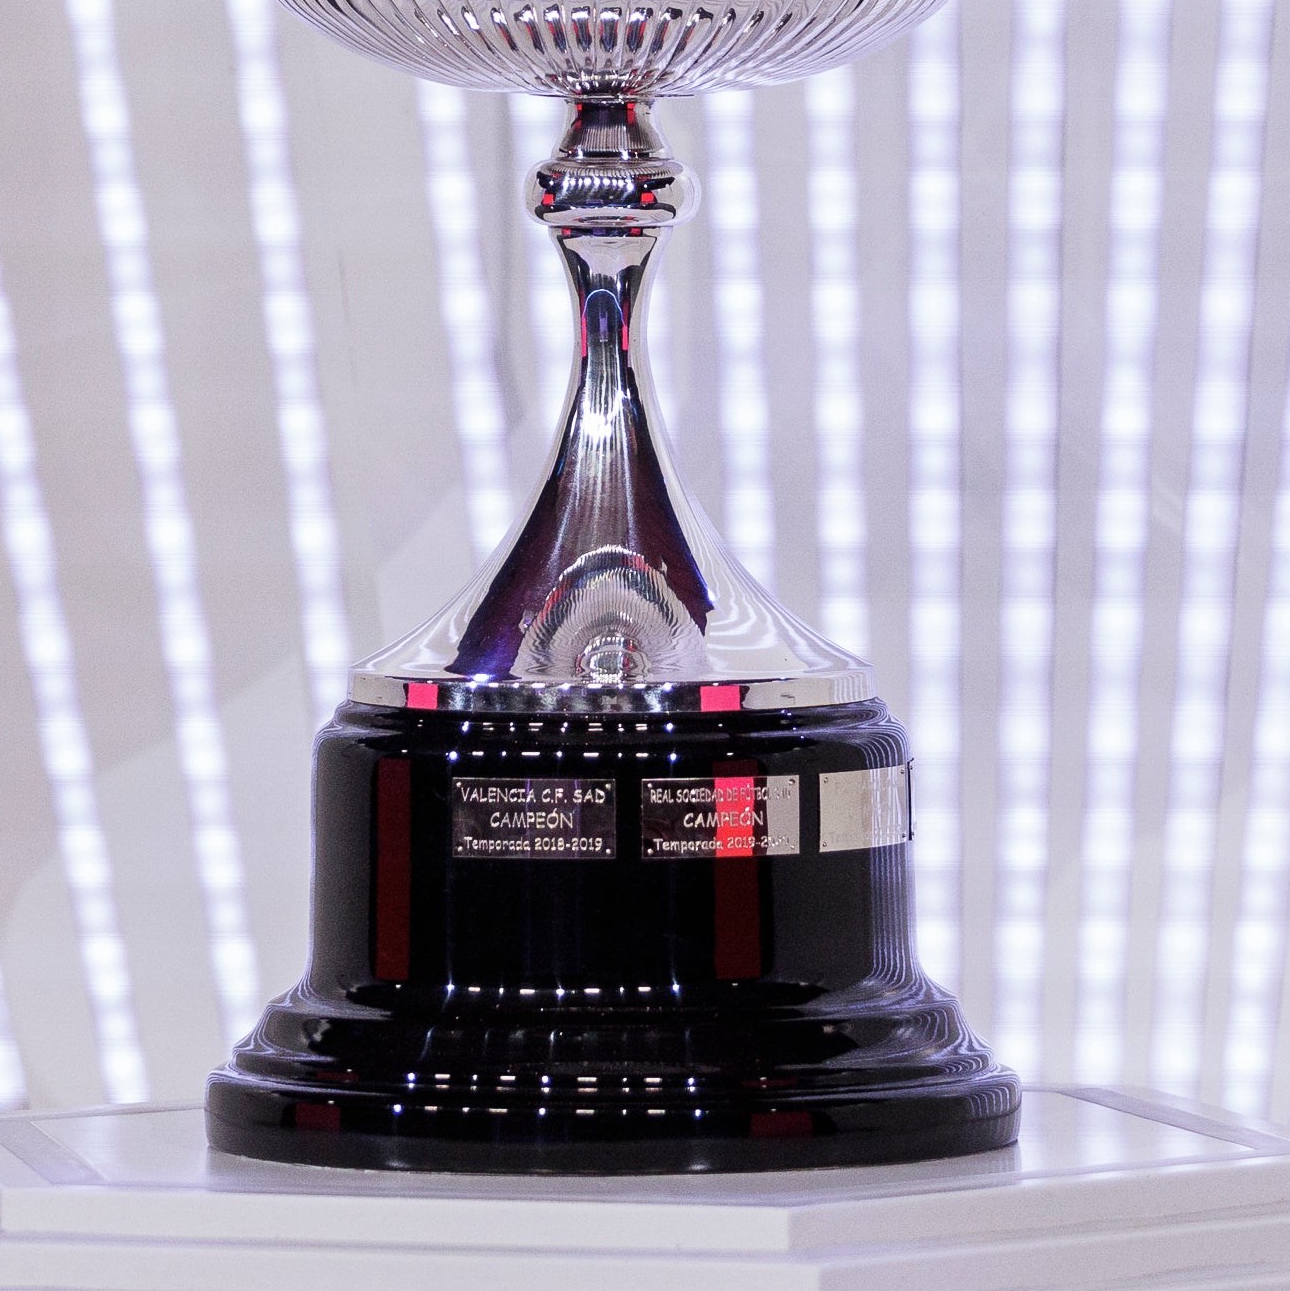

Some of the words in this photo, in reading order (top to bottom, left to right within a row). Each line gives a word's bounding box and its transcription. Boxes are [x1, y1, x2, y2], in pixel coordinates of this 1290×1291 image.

[461, 787, 537, 803] VALENCIA
[541, 788, 568, 803] C.F.
[572, 788, 606, 804] SAD
[650, 788, 674, 803] REAL
[676, 788, 724, 803] SOCIEDAD
[726, 787, 738, 802] DE
[740, 783, 772, 802] FÚTBO
[490, 808, 574, 829] CAMPEÓN
[683, 806, 764, 828] CAMPEÓN
[463, 836, 531, 853] Temporada
[534, 837, 603, 851] 2018-2019
[653, 837, 724, 853] Temporada
[727, 835, 790, 850] 2019-2
